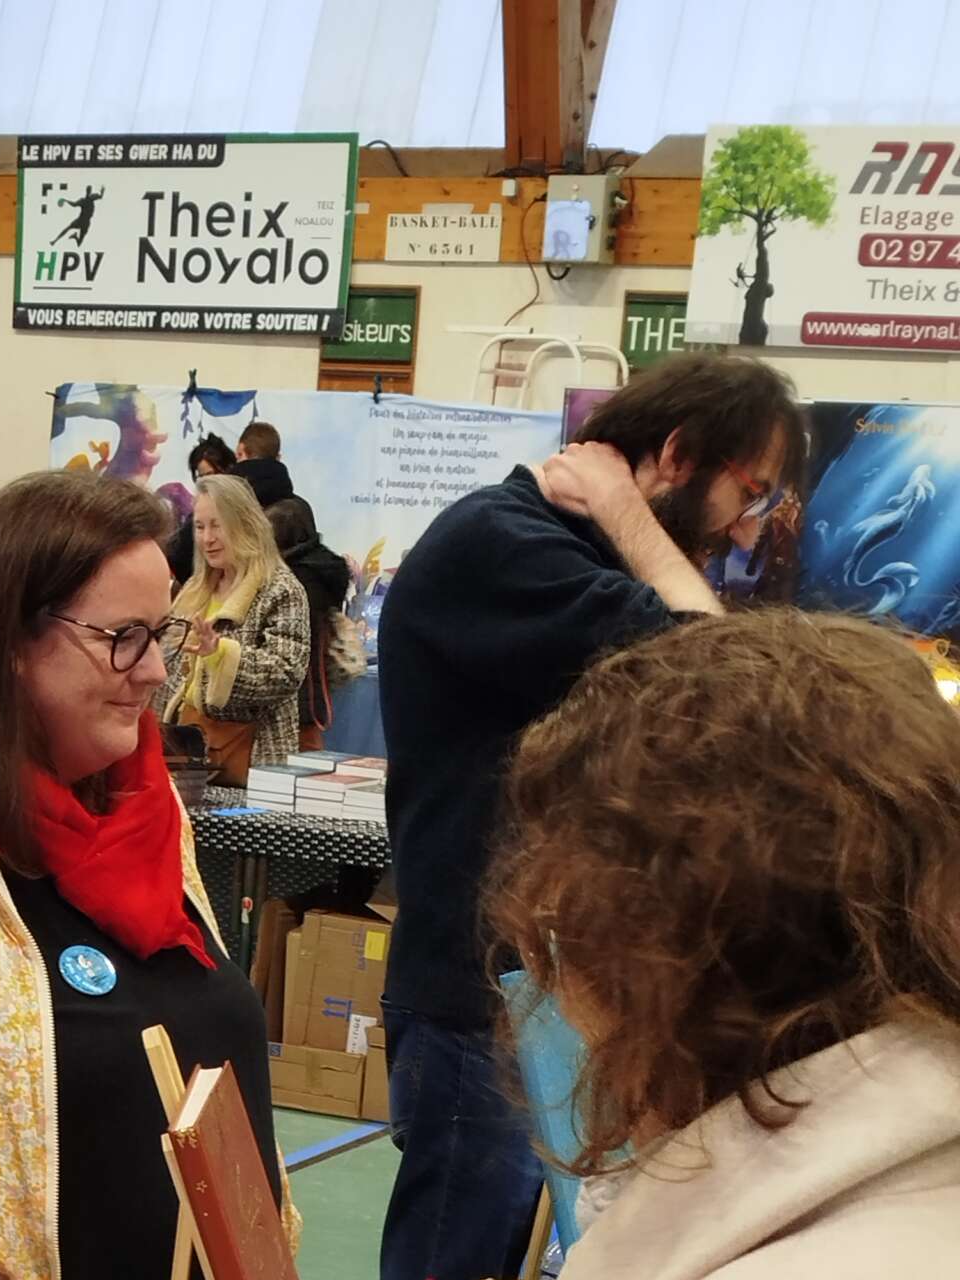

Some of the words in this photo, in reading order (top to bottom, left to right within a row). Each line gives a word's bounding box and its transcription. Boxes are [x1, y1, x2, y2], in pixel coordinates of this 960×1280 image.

[22, 144, 39, 161] LE
[43, 144, 71, 161] HPV
[74, 144, 94, 161] ET
[97, 144, 123, 160] SES
[129, 144, 168, 160] GWER
[172, 144, 193, 160] HA
[198, 143, 217, 160] DU
[141, 191, 290, 238] Theix
[389, 214, 499, 229] BASKET-BALL
[859, 205, 954, 231] Elagage
[136, 236, 330, 285] Noyalo
[870, 239, 903, 262] 02
[909, 239, 943, 263] 97
[35, 251, 104, 282] HPV
[866, 278, 937, 302] Theix
[27, 308, 63, 326] VOUS
[66, 309, 156, 328] REMERCIENT
[161, 311, 199, 329] POUR
[203, 312, 252, 330] VOTRE
[256, 313, 319, 331] SOUTIEN
[342, 319, 411, 343] siteurs
[627, 316, 686, 352] THE
